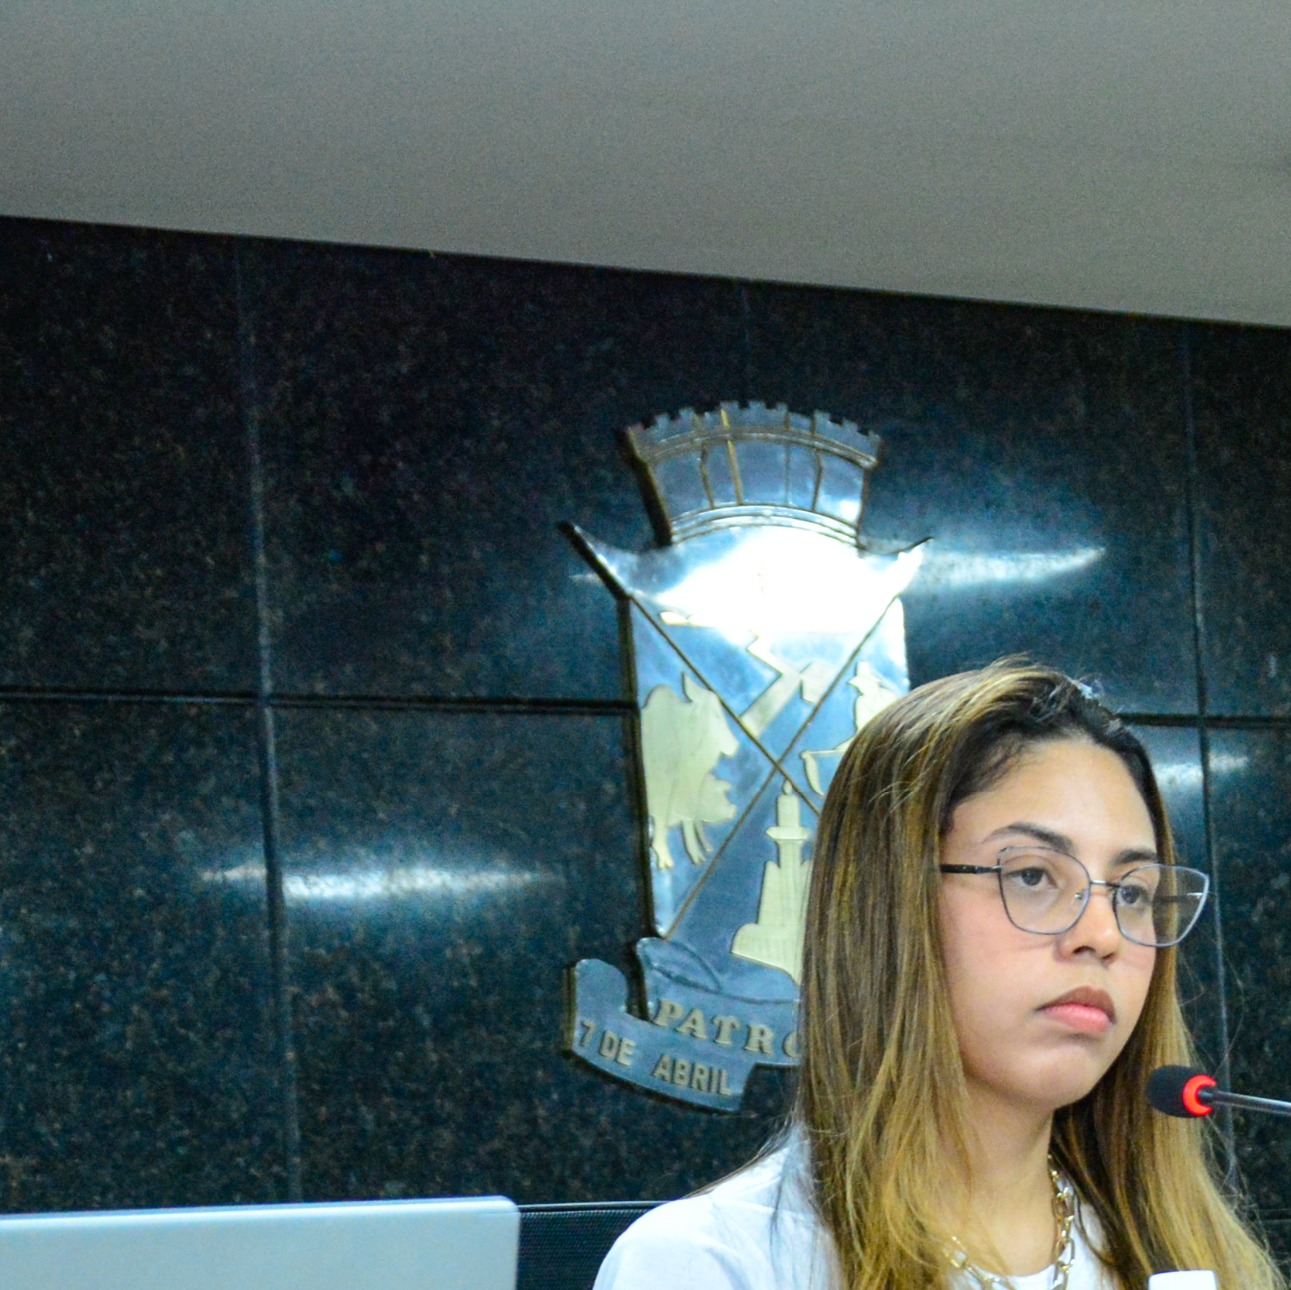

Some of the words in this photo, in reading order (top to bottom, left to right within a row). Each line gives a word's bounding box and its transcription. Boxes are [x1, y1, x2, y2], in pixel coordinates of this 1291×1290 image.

[579, 1019, 596, 1048] 7
[598, 1030, 637, 1067] DE
[653, 1054, 733, 1097] ABRIL
